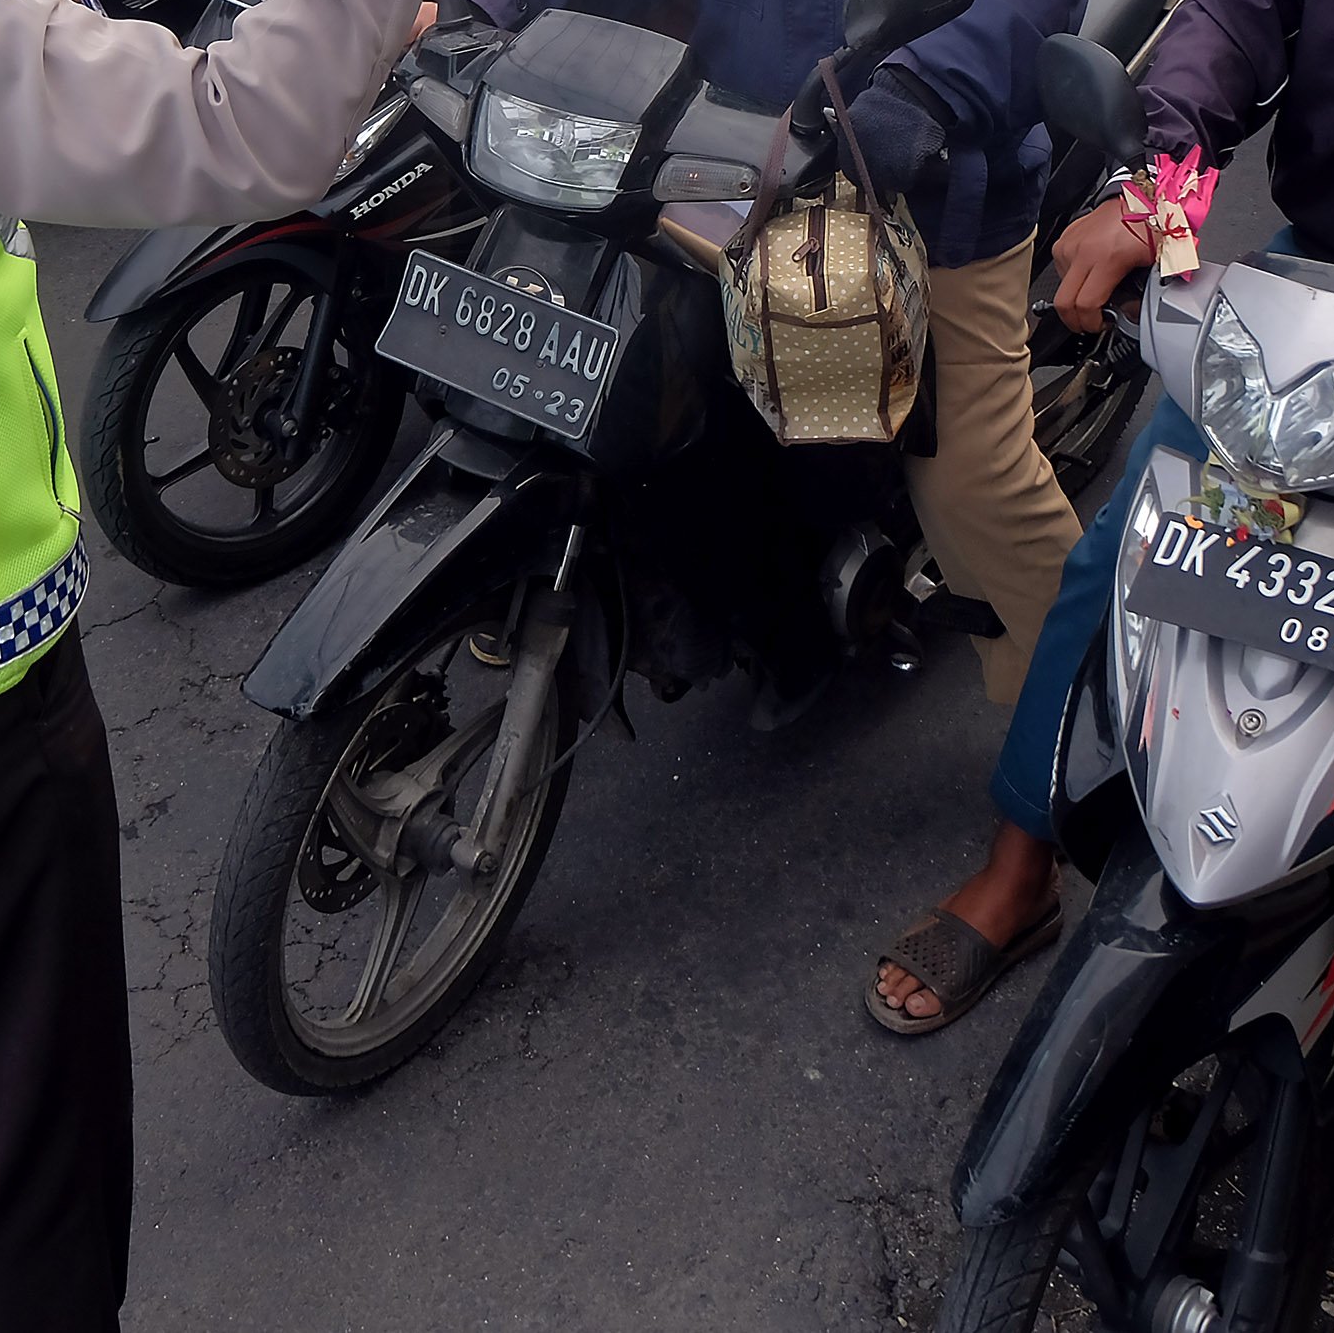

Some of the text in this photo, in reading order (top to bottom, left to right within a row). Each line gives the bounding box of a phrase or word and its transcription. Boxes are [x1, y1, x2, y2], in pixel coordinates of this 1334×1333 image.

[349, 162, 434, 221] HONDA
[404, 265, 610, 381] DK 6828 AAU
[1152, 519, 1221, 577] DK
